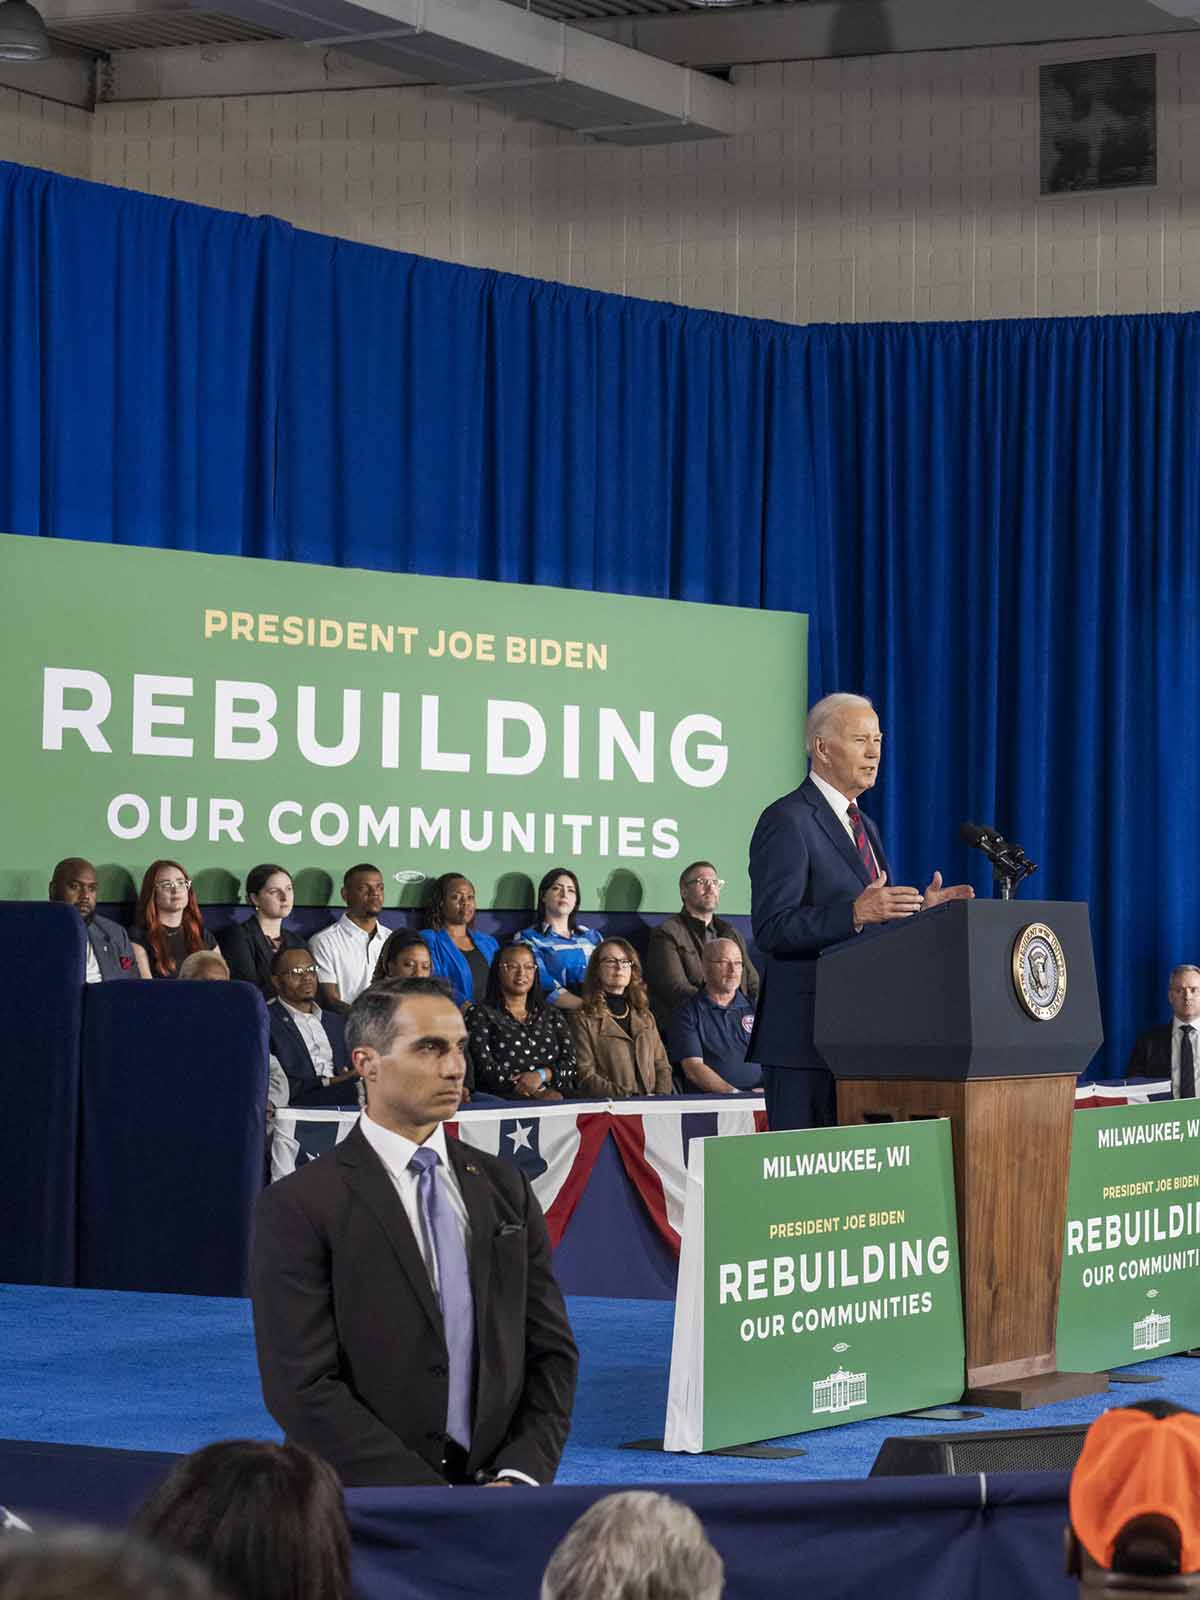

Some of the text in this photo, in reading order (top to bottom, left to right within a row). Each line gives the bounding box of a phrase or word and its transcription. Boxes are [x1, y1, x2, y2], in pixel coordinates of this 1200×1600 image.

[205, 609, 608, 671] PRESIDENT JOE BIDEN
[42, 667, 729, 789] REBUILDING
[106, 793, 681, 860] OUR COMMUNITIES
[1098, 1121, 1185, 1149] MILWAUKEE,
[763, 1145, 910, 1180] MILWAUKEE, WI
[1103, 1175, 1200, 1200] PRESIDENT JOE BIDEN
[769, 1209, 905, 1239] PRESIDENT JOE BIDEN
[719, 1235, 950, 1305] REBUILDING
[1082, 1264, 1115, 1288] OUR
[740, 1291, 933, 1342] OUR COMMUNITIES
